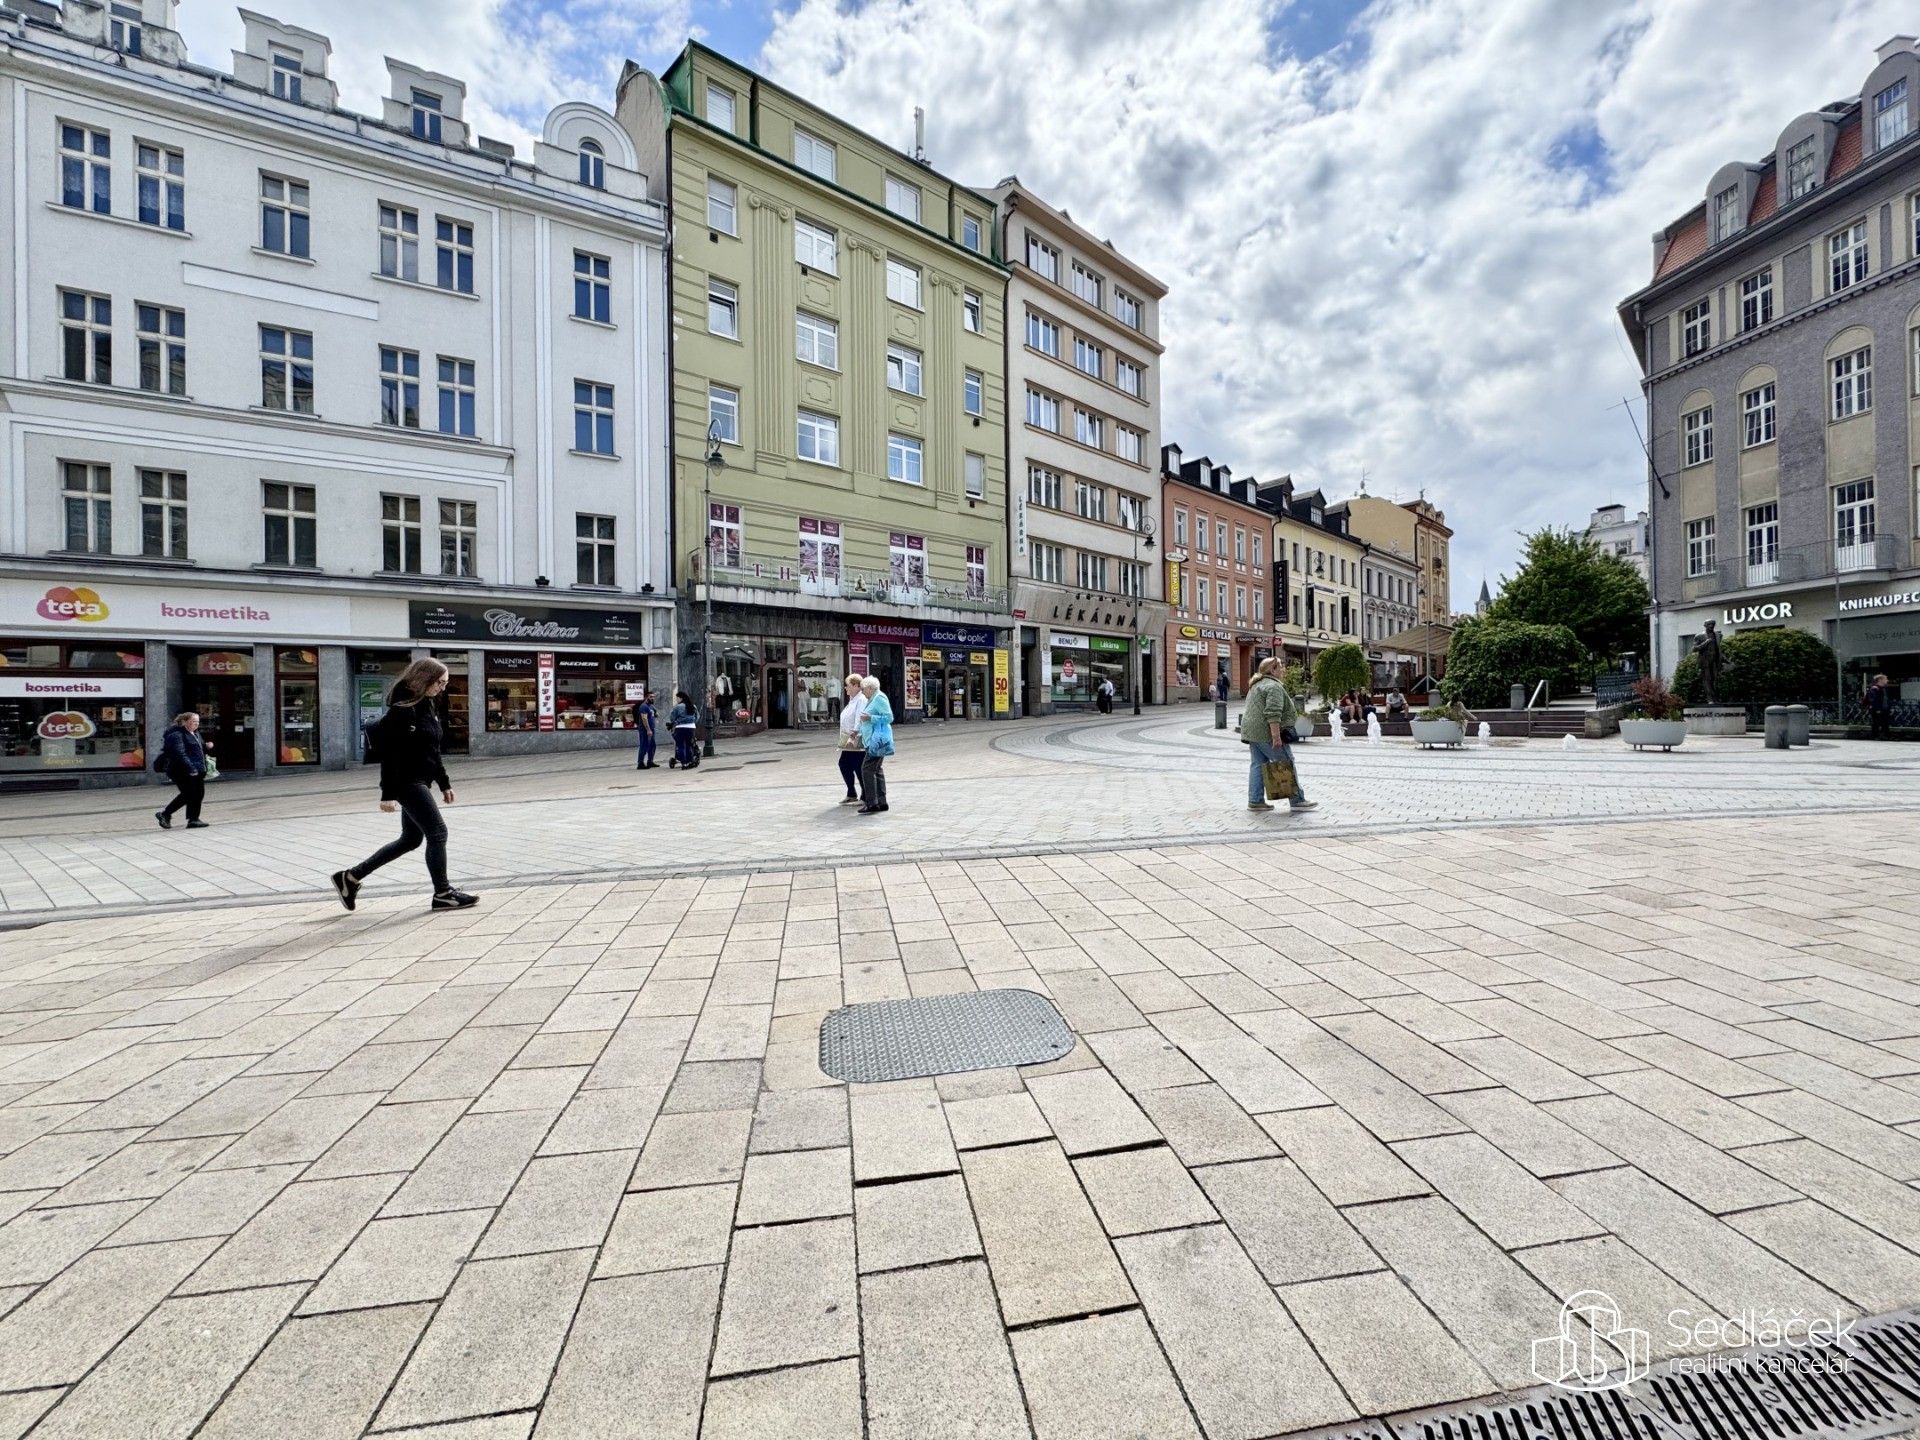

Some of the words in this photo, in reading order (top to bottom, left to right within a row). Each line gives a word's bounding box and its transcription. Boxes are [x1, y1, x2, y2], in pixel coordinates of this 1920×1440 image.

[752, 563, 839, 586] THAI
[878, 578, 1008, 606] MASSAGE
[1839, 591, 1920, 611] KNIHKUPEC
[47, 598, 101, 616] teta
[161, 602, 270, 621] kosmetika
[1723, 602, 1792, 625] LUXOR
[1053, 604, 1137, 629] LÉKÁRNA
[483, 608, 579, 638] Christina
[853, 623, 877, 634] THAI
[931, 627, 957, 640] doctor
[967, 634, 985, 644] optic
[1058, 637, 1072, 645] BENU
[1100, 640, 1119, 649] Lékárna
[208, 660, 242, 671] teta
[493, 657, 532, 665] VALENTINO
[798, 670, 827, 678] ACOSTE
[25, 682, 102, 693] kosmetika
[995, 678, 1008, 690] 50
[47, 721, 85, 733] teta
